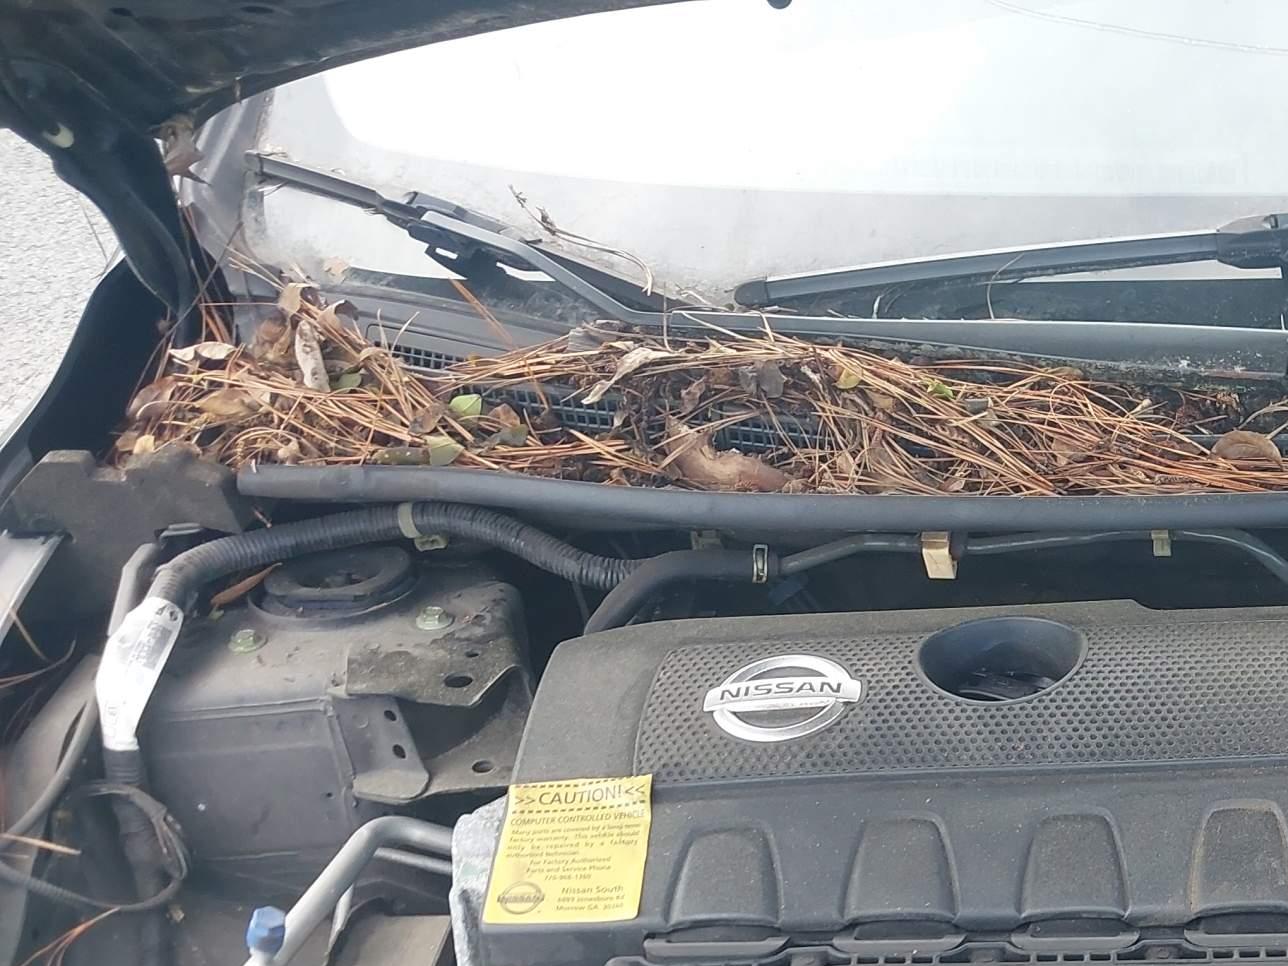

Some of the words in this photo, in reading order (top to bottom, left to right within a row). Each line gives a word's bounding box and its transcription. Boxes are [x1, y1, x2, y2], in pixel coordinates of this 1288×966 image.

[720, 681, 842, 701] NISSAN
[510, 816, 556, 827] COMPUTER
[558, 812, 612, 824] CONTROLLED
[613, 808, 646, 820] VEHICLE
[543, 857, 569, 866] Factory
[561, 887, 594, 895] Nissan
[595, 885, 624, 894] South
